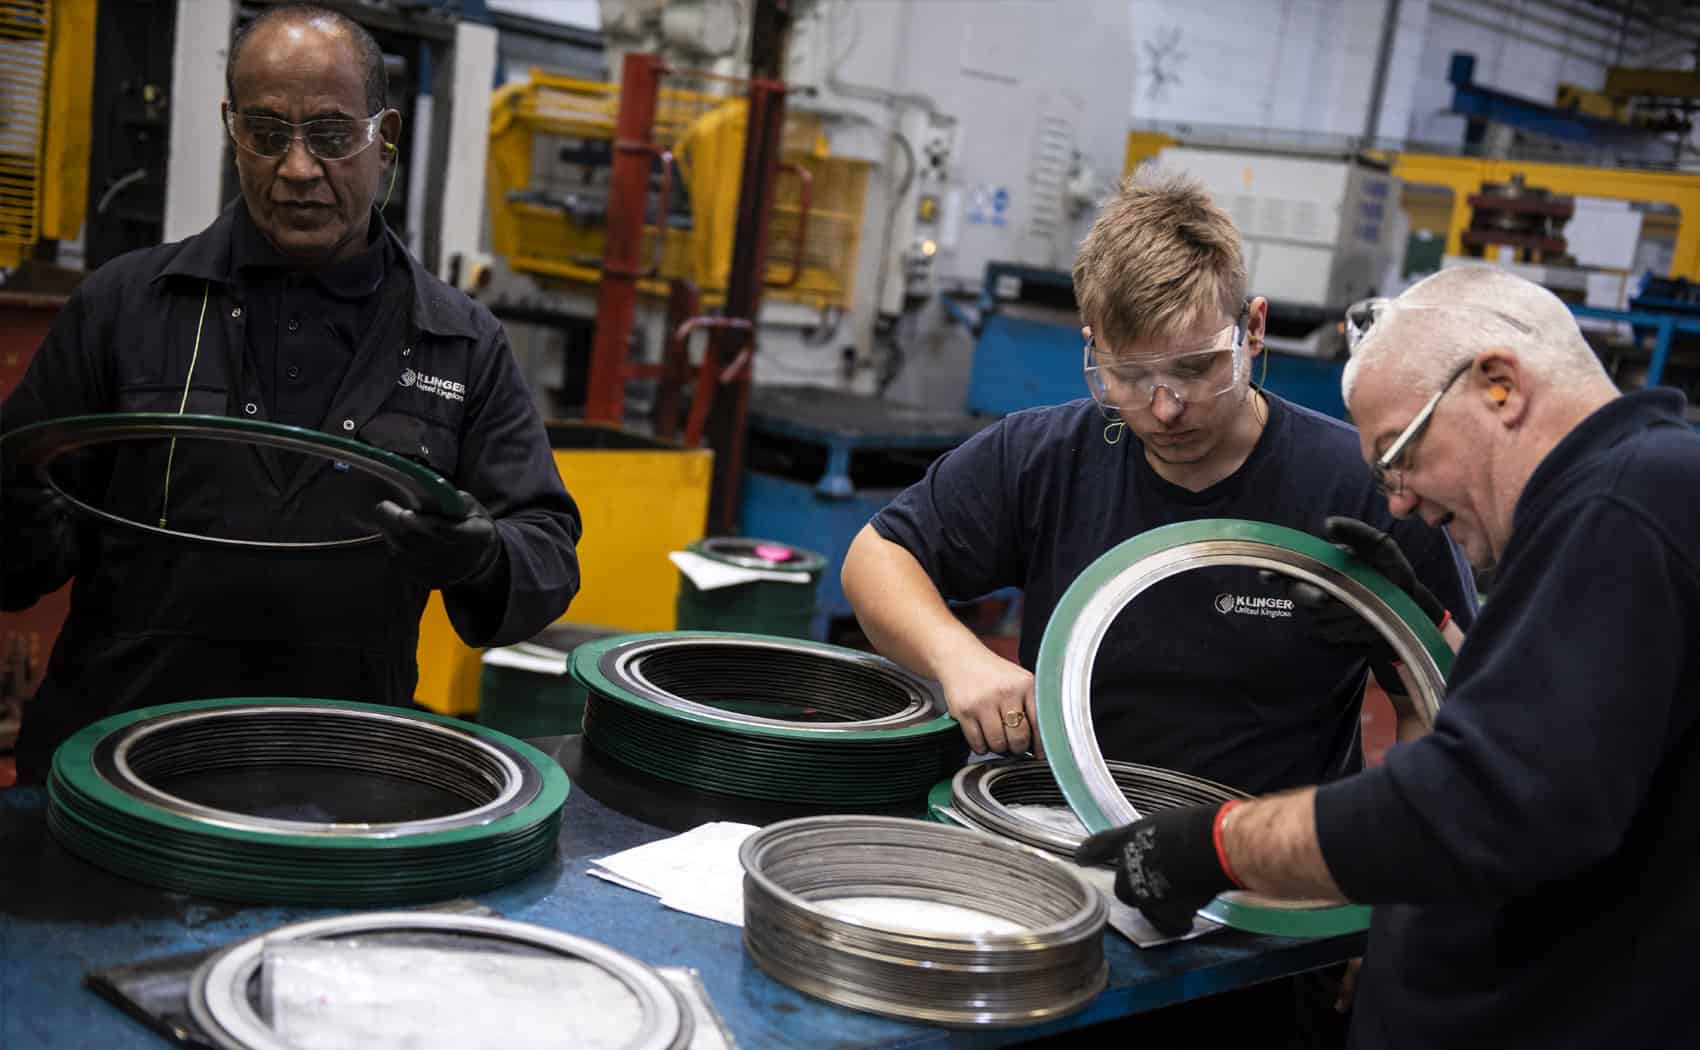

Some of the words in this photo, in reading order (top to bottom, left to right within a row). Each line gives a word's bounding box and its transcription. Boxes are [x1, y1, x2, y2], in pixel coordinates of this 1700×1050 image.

[1236, 596, 1293, 610] KLINGER
[1234, 606, 1259, 615] United
[1260, 607, 1292, 618] Kingdom
